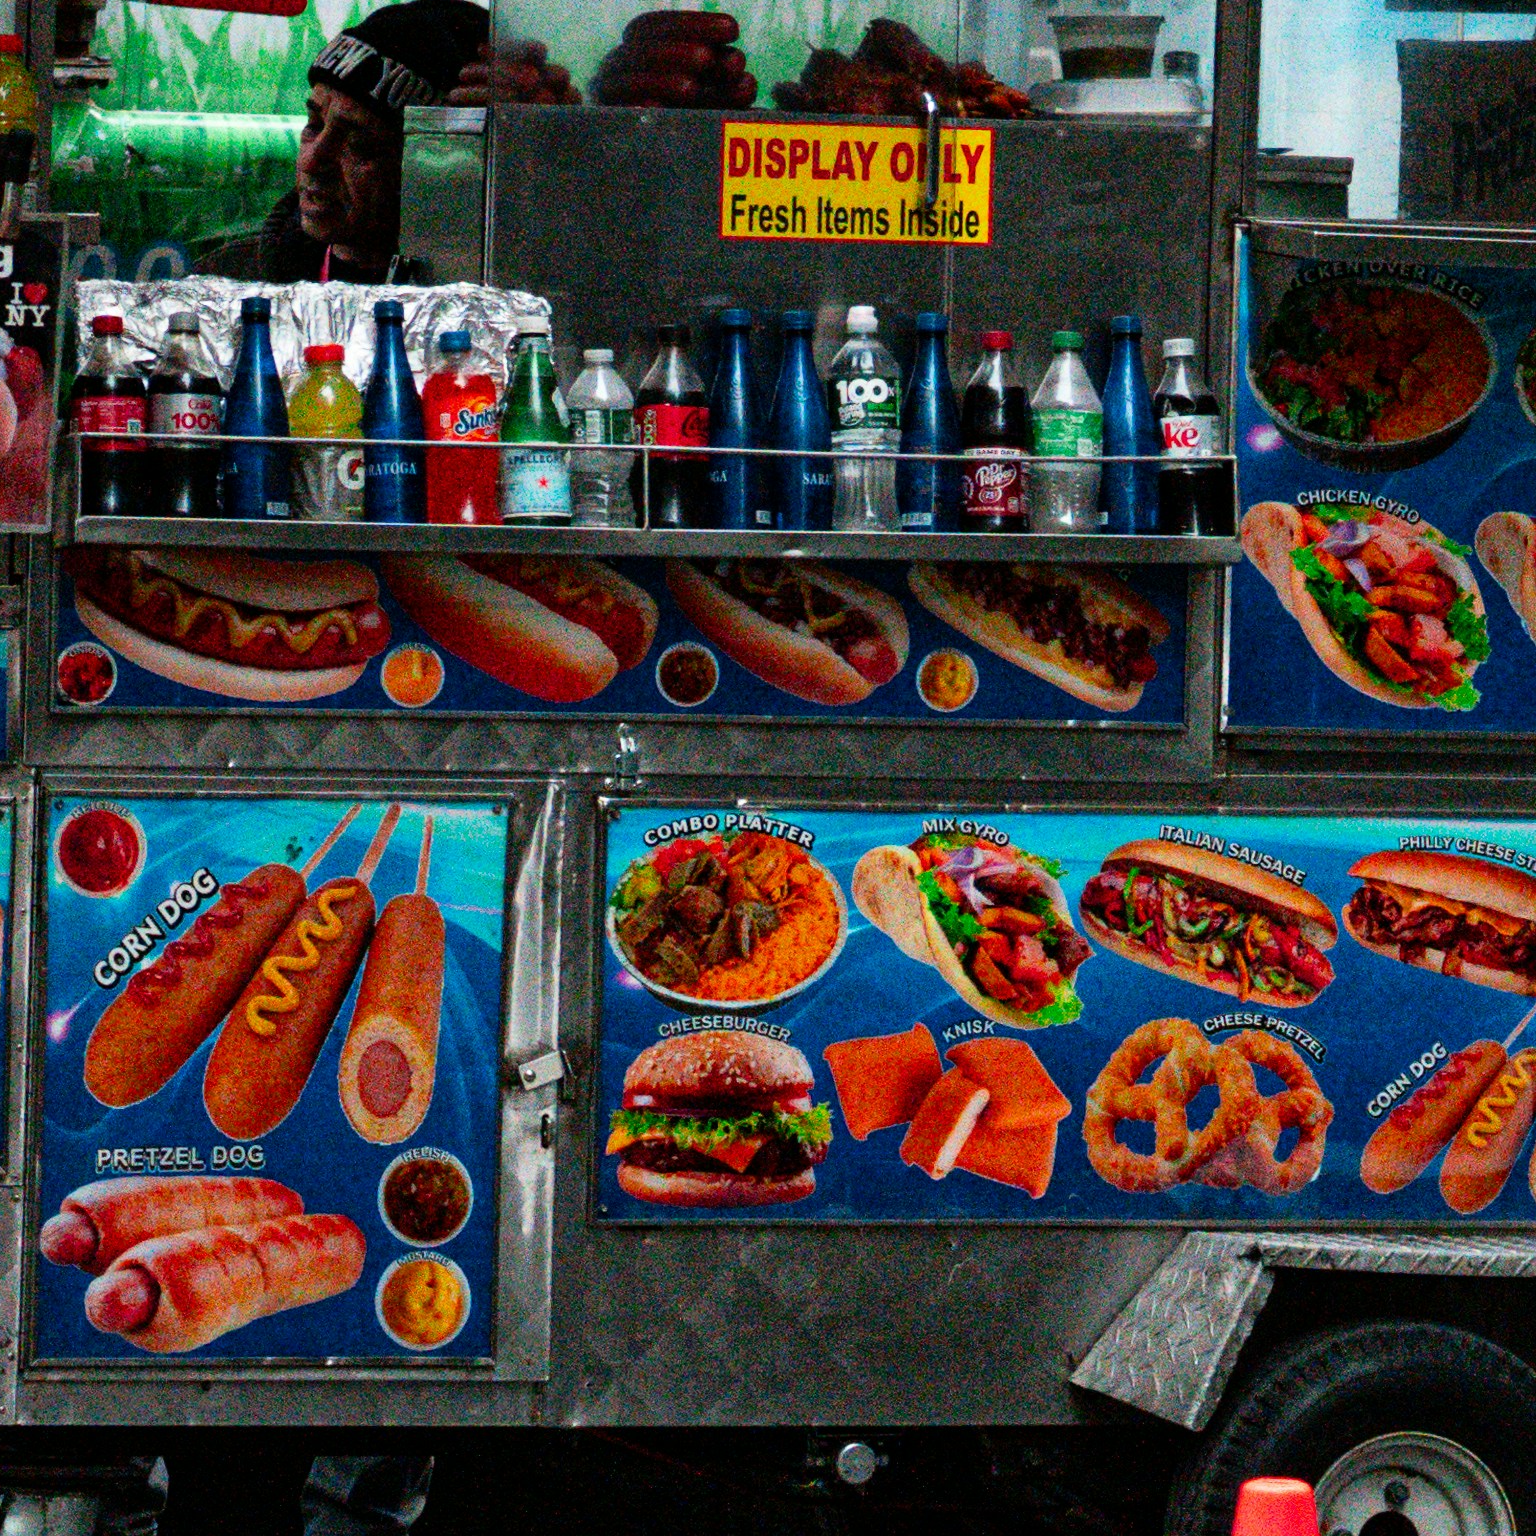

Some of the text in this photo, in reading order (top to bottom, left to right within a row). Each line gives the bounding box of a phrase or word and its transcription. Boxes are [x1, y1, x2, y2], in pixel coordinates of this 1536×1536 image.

[727, 136, 880, 182] DISPLAY
[730, 194, 980, 238] Fresh Items Inside
[10, 281, 24, 305] I
[1432, 273, 1485, 309] RICE
[4, 303, 51, 328] NY
[975, 467, 1017, 488] Pepper
[1295, 488, 1422, 524] CHICKEN GYRO
[643, 813, 816, 850] COMBO PLATTER
[921, 817, 1010, 846] MIX GYRO
[1398, 835, 1453, 852] PHILLY
[1455, 835, 1516, 863] CHEESE
[1158, 824, 1307, 886] ITALIAN SAUSAGE
[93, 866, 220, 988] CORN DOG
[658, 1015, 792, 1044] CHEESEBURGER
[1202, 1013, 1326, 1063] CHEESE PRETZEL
[1366, 1042, 1450, 1120] CORN DOG
[96, 1145, 266, 1173] PRETZEL DOG
